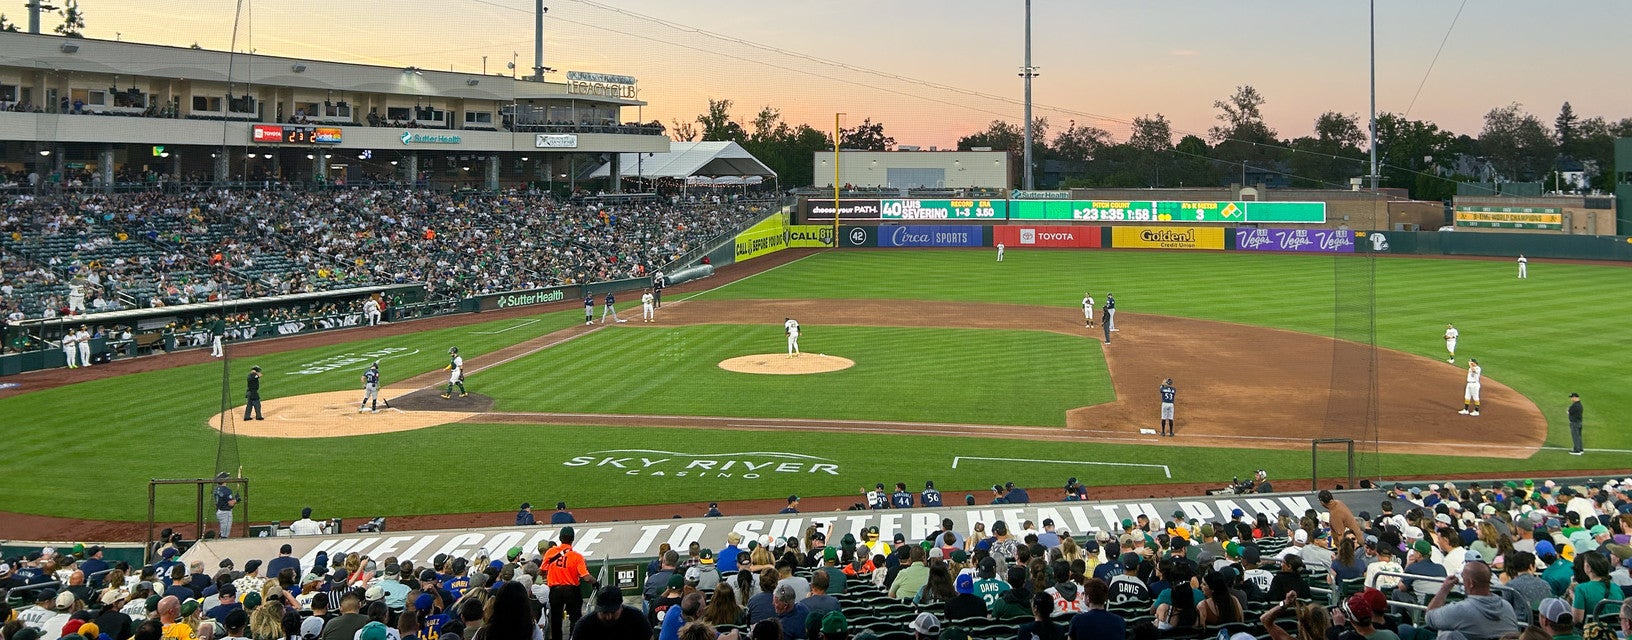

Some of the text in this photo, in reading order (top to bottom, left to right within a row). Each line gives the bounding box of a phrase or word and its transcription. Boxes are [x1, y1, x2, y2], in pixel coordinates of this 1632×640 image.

[567, 81, 635, 98] LEGACY CLUB
[414, 134, 461, 144] Sutter Health
[1022, 191, 1070, 199] Sutter Health
[883, 202, 902, 217] 40
[902, 200, 921, 208] LUIS
[902, 208, 948, 218] SEVERINO
[955, 208, 971, 217] 1-3
[1195, 209, 1205, 220] 3
[791, 229, 833, 241] CALL 811
[852, 231, 863, 241] 42
[892, 226, 968, 247] Circa SPORTS
[1038, 232, 1074, 241] TOYOTA
[1237, 230, 1274, 249] Vegas
[1276, 231, 1313, 250] Vegas
[1315, 231, 1353, 250] Vegas
[507, 289, 563, 307] Sutter Health
[563, 456, 839, 475] SKY RIVER
[625, 469, 760, 479] CASINO
[926, 493, 939, 503] 56
[300, 495, 1326, 567] WELCOME TO SUTTER HEALTH PARK
[155, 566, 175, 580] 24
[1249, 575, 1269, 586] AVIS
[980, 582, 999, 593] DAVIS
[1118, 582, 1140, 595] DAVIS
